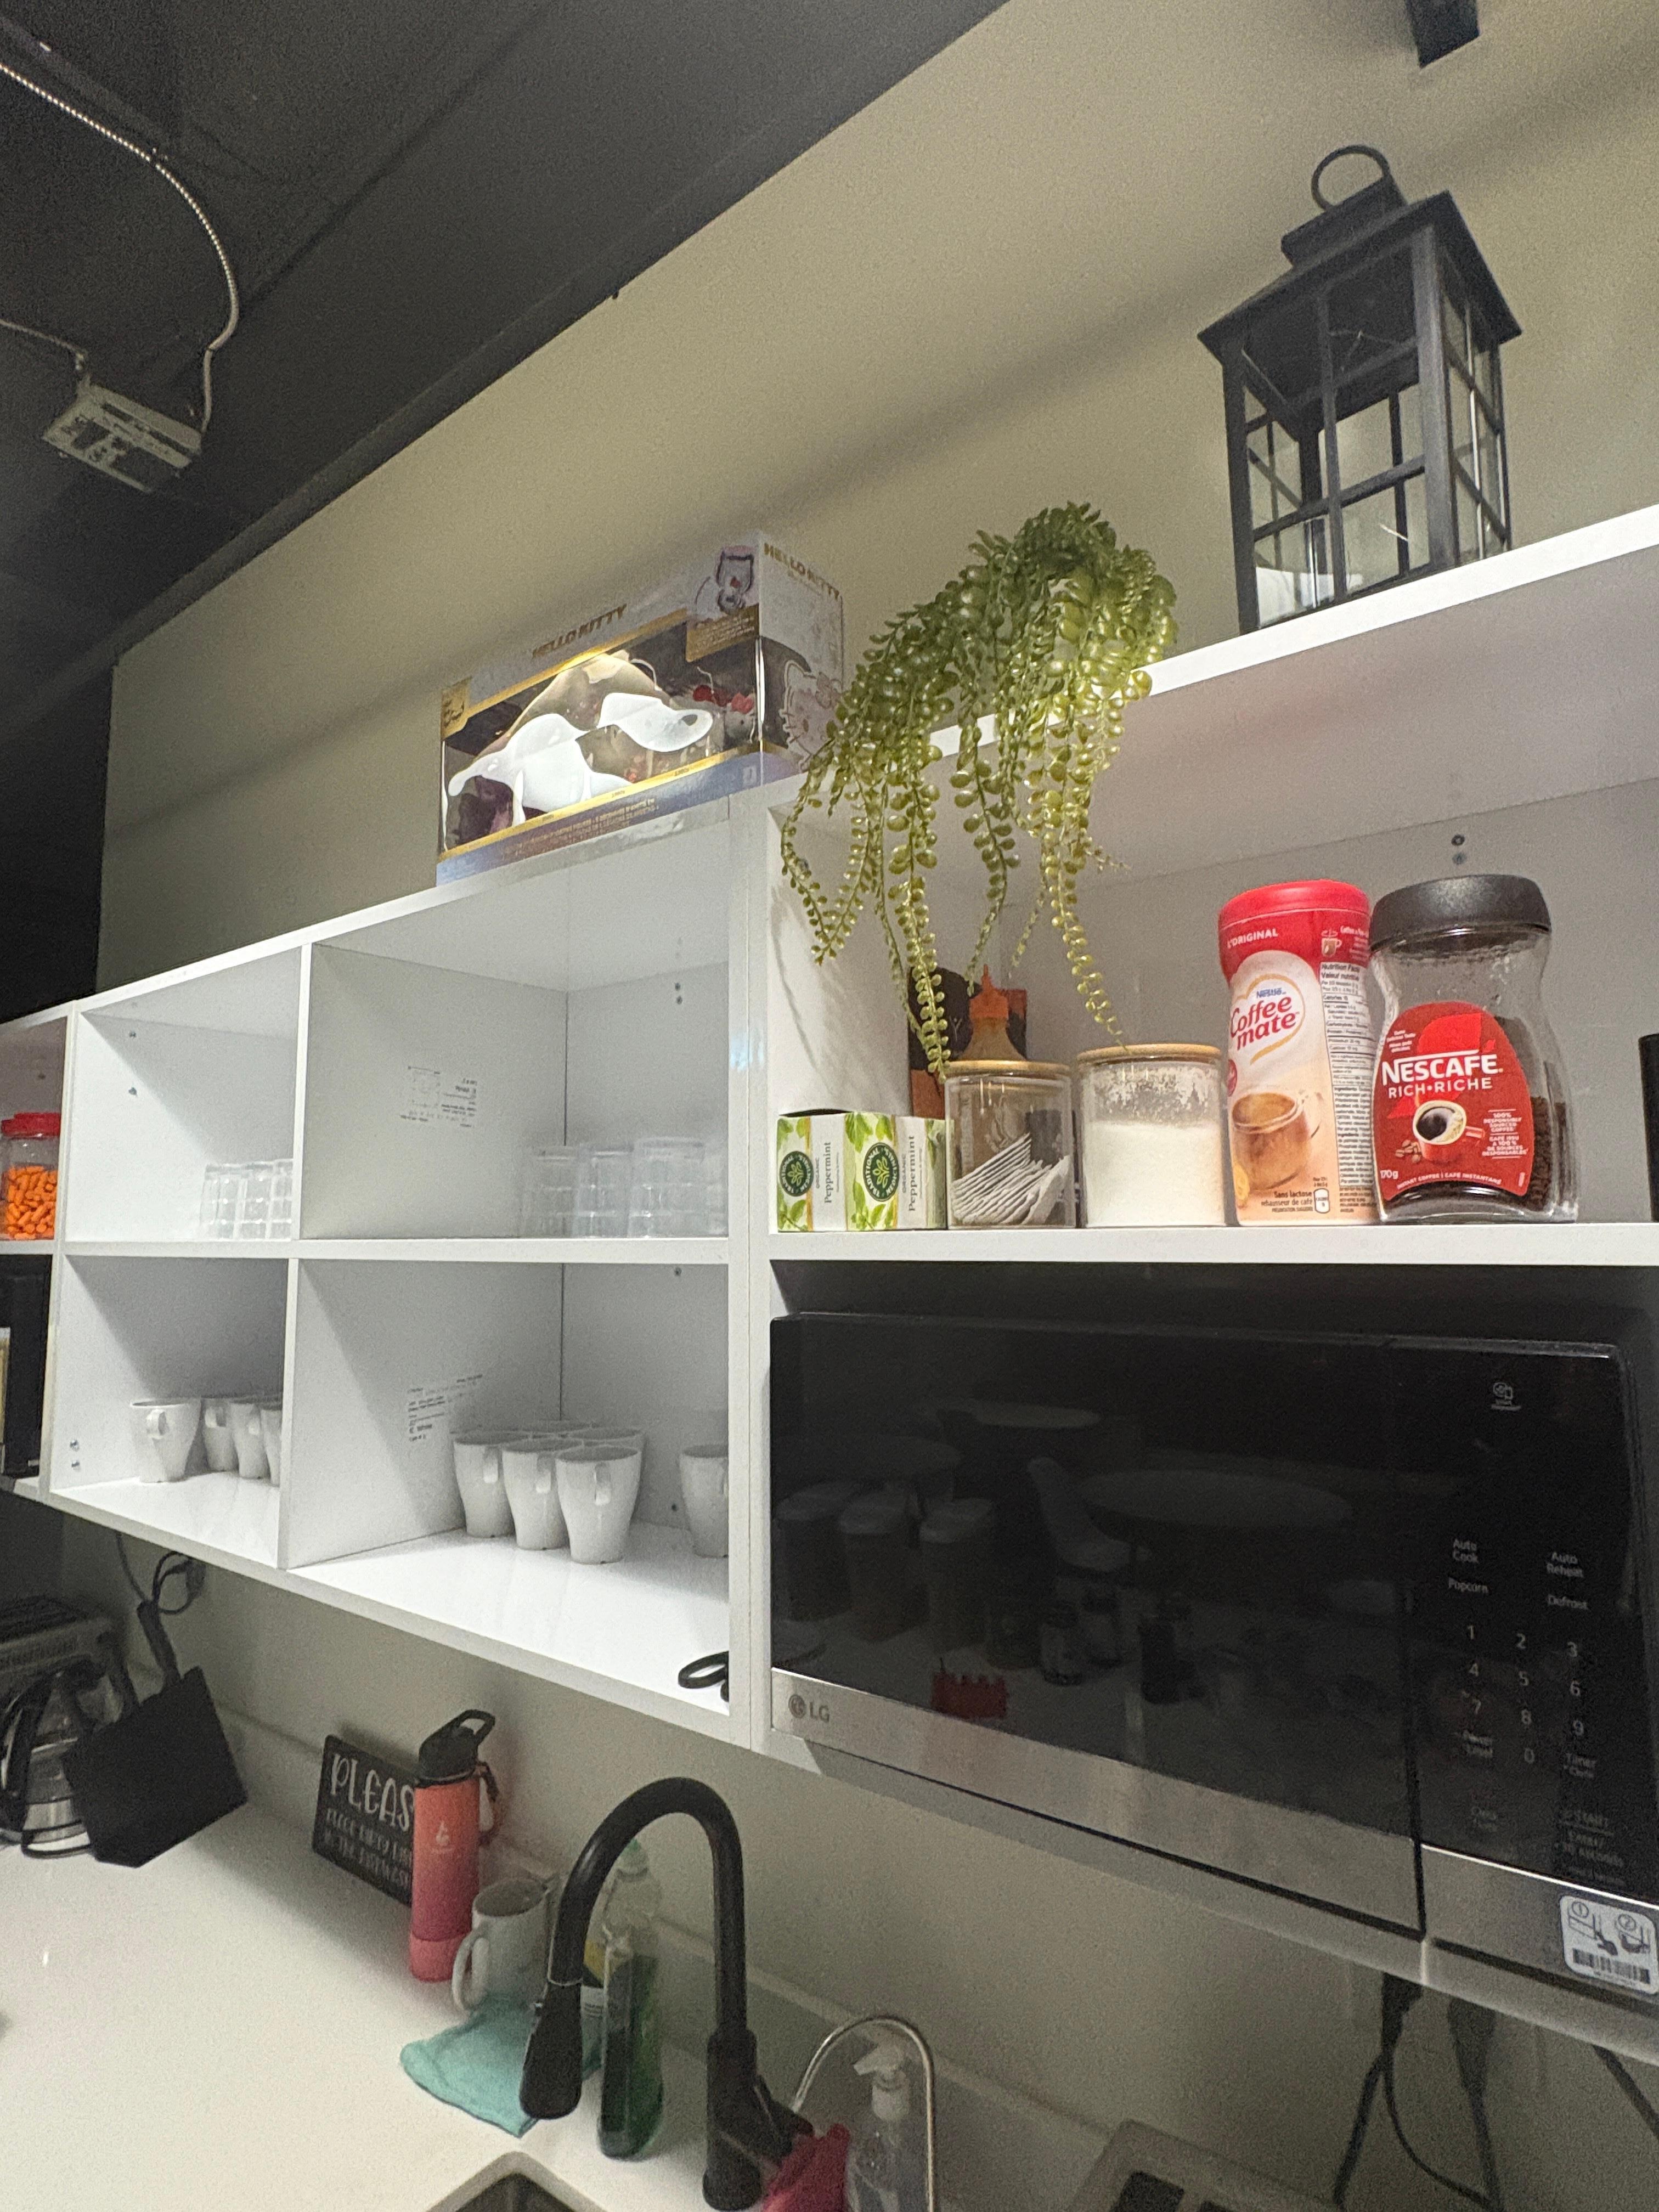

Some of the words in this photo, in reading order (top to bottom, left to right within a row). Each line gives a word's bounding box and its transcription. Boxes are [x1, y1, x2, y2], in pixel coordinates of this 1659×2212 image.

[1231, 996, 1292, 1038] Coffee
[1237, 1013, 1296, 1051] mate
[824, 1142, 833, 1203] Peppermint
[909, 1136, 917, 1211] Peppermint
[1551, 1551, 1578, 1564] Auto
[1466, 1624, 1475, 1640] 1
[1516, 1632, 1527, 1650] 2
[1567, 1641, 1578, 1657] 3
[1469, 1662, 1479, 1677] 4
[1518, 1671, 1530, 1686] 5
[1570, 1680, 1581, 1697] 6
[1472, 1699, 1482, 1715] 7
[1521, 1709, 1532, 1725] 8
[1572, 1719, 1584, 1736] 9
[1523, 1747, 1535, 1764] 0
